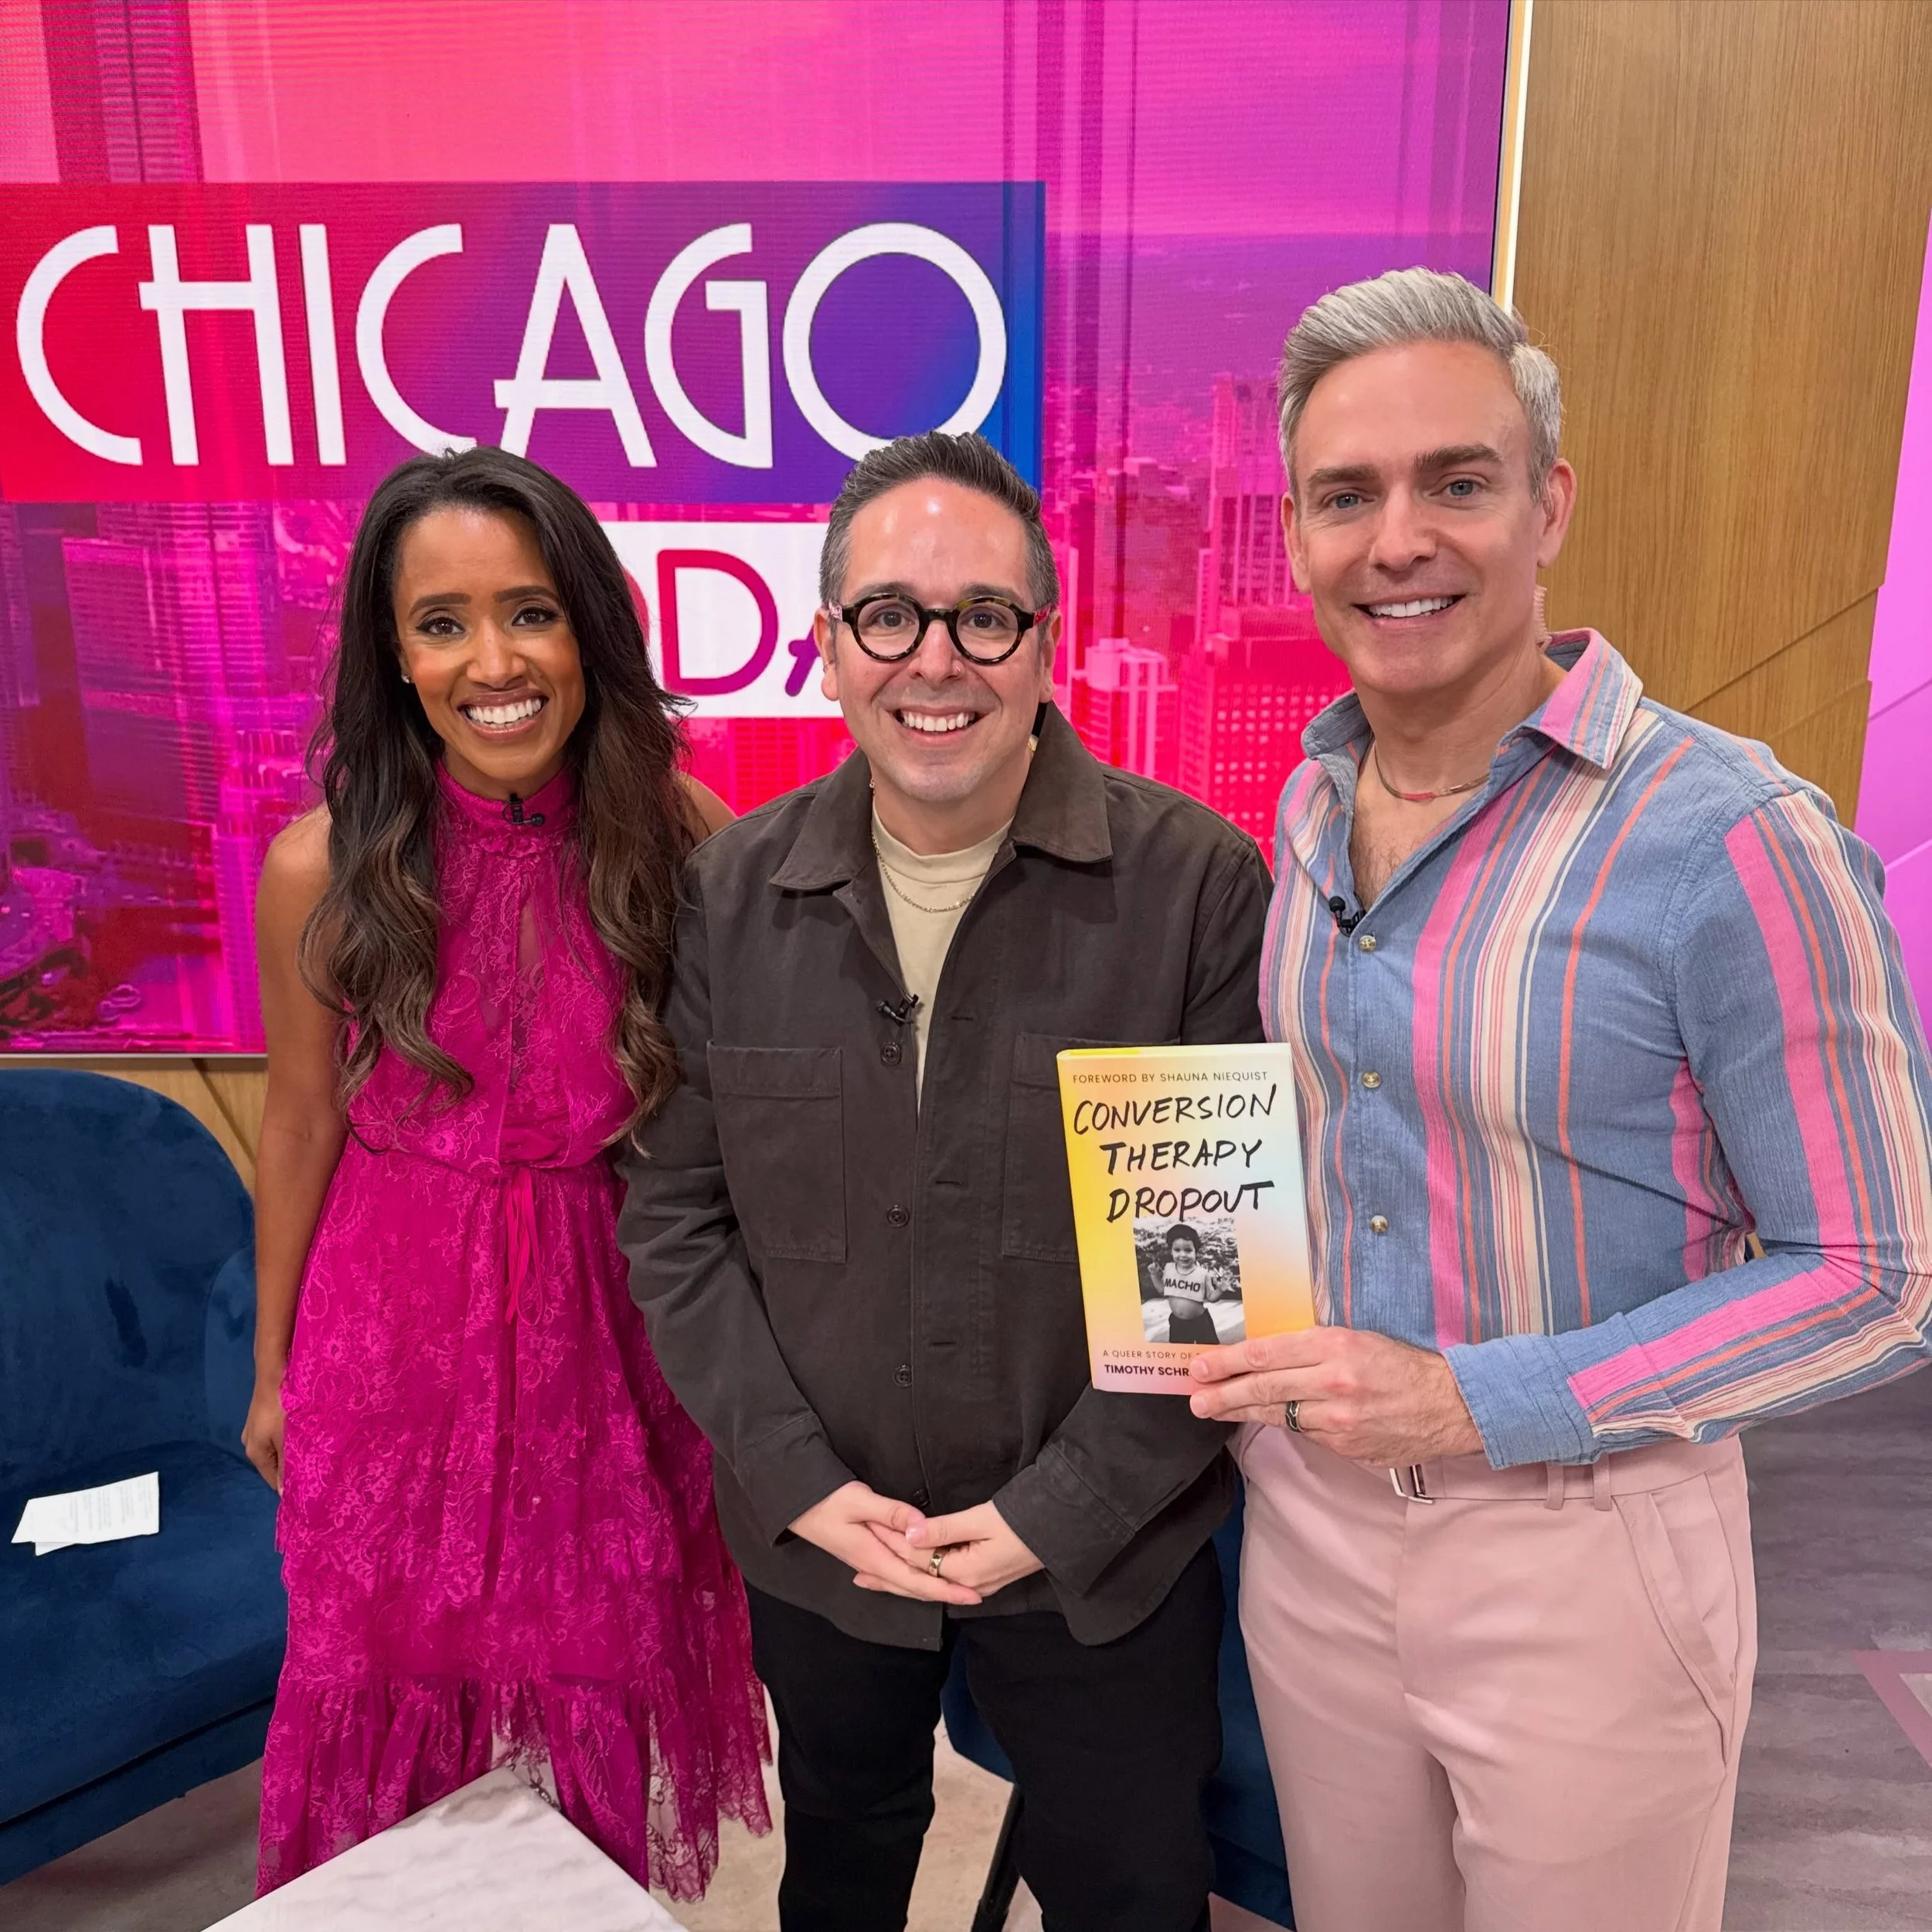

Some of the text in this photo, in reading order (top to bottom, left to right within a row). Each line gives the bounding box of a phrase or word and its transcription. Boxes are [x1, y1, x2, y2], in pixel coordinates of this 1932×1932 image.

[16, 223, 1007, 468] CHICAGO
[1073, 1071, 1268, 1083] FOREWORD BY SHAUNA NIEQUIST
[1073, 1083, 1277, 1135] CONVERSION
[1100, 1138, 1263, 1175] THERAPY
[1107, 1180, 1275, 1223] DROPOUT
[1164, 1278, 1201, 1292] MACHO
[1104, 1364, 1191, 1377] TIMOTHY SCHR
